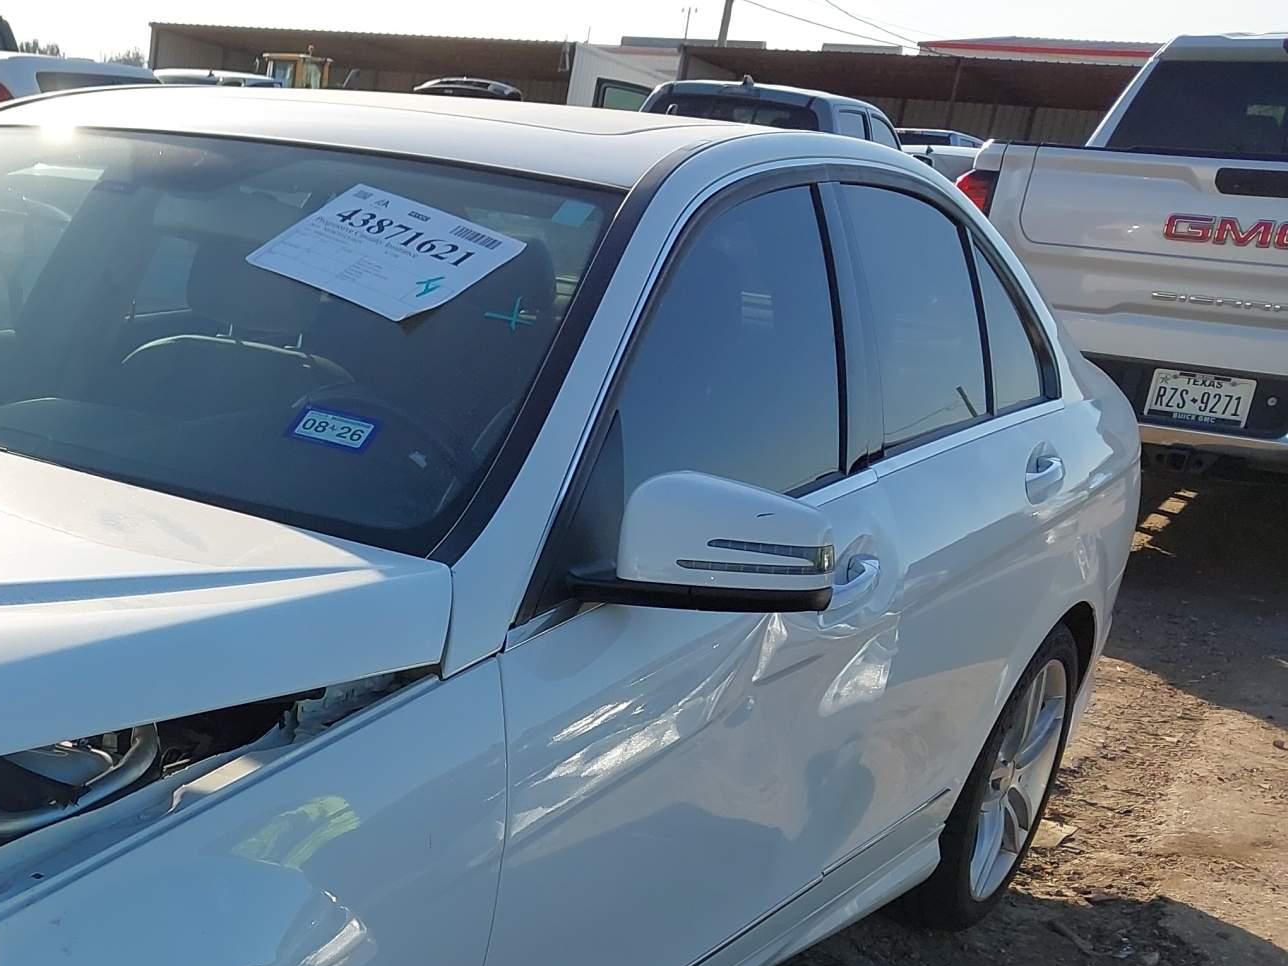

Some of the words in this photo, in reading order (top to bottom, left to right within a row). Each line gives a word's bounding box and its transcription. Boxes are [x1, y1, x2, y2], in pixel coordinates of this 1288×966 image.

[336, 208, 475, 266] 43871621
[1186, 377, 1224, 389] TEXAS
[1154, 386, 1189, 409] RZS
[1198, 391, 1243, 417] 9271
[302, 418, 329, 433] 08
[336, 426, 365, 442] 26
